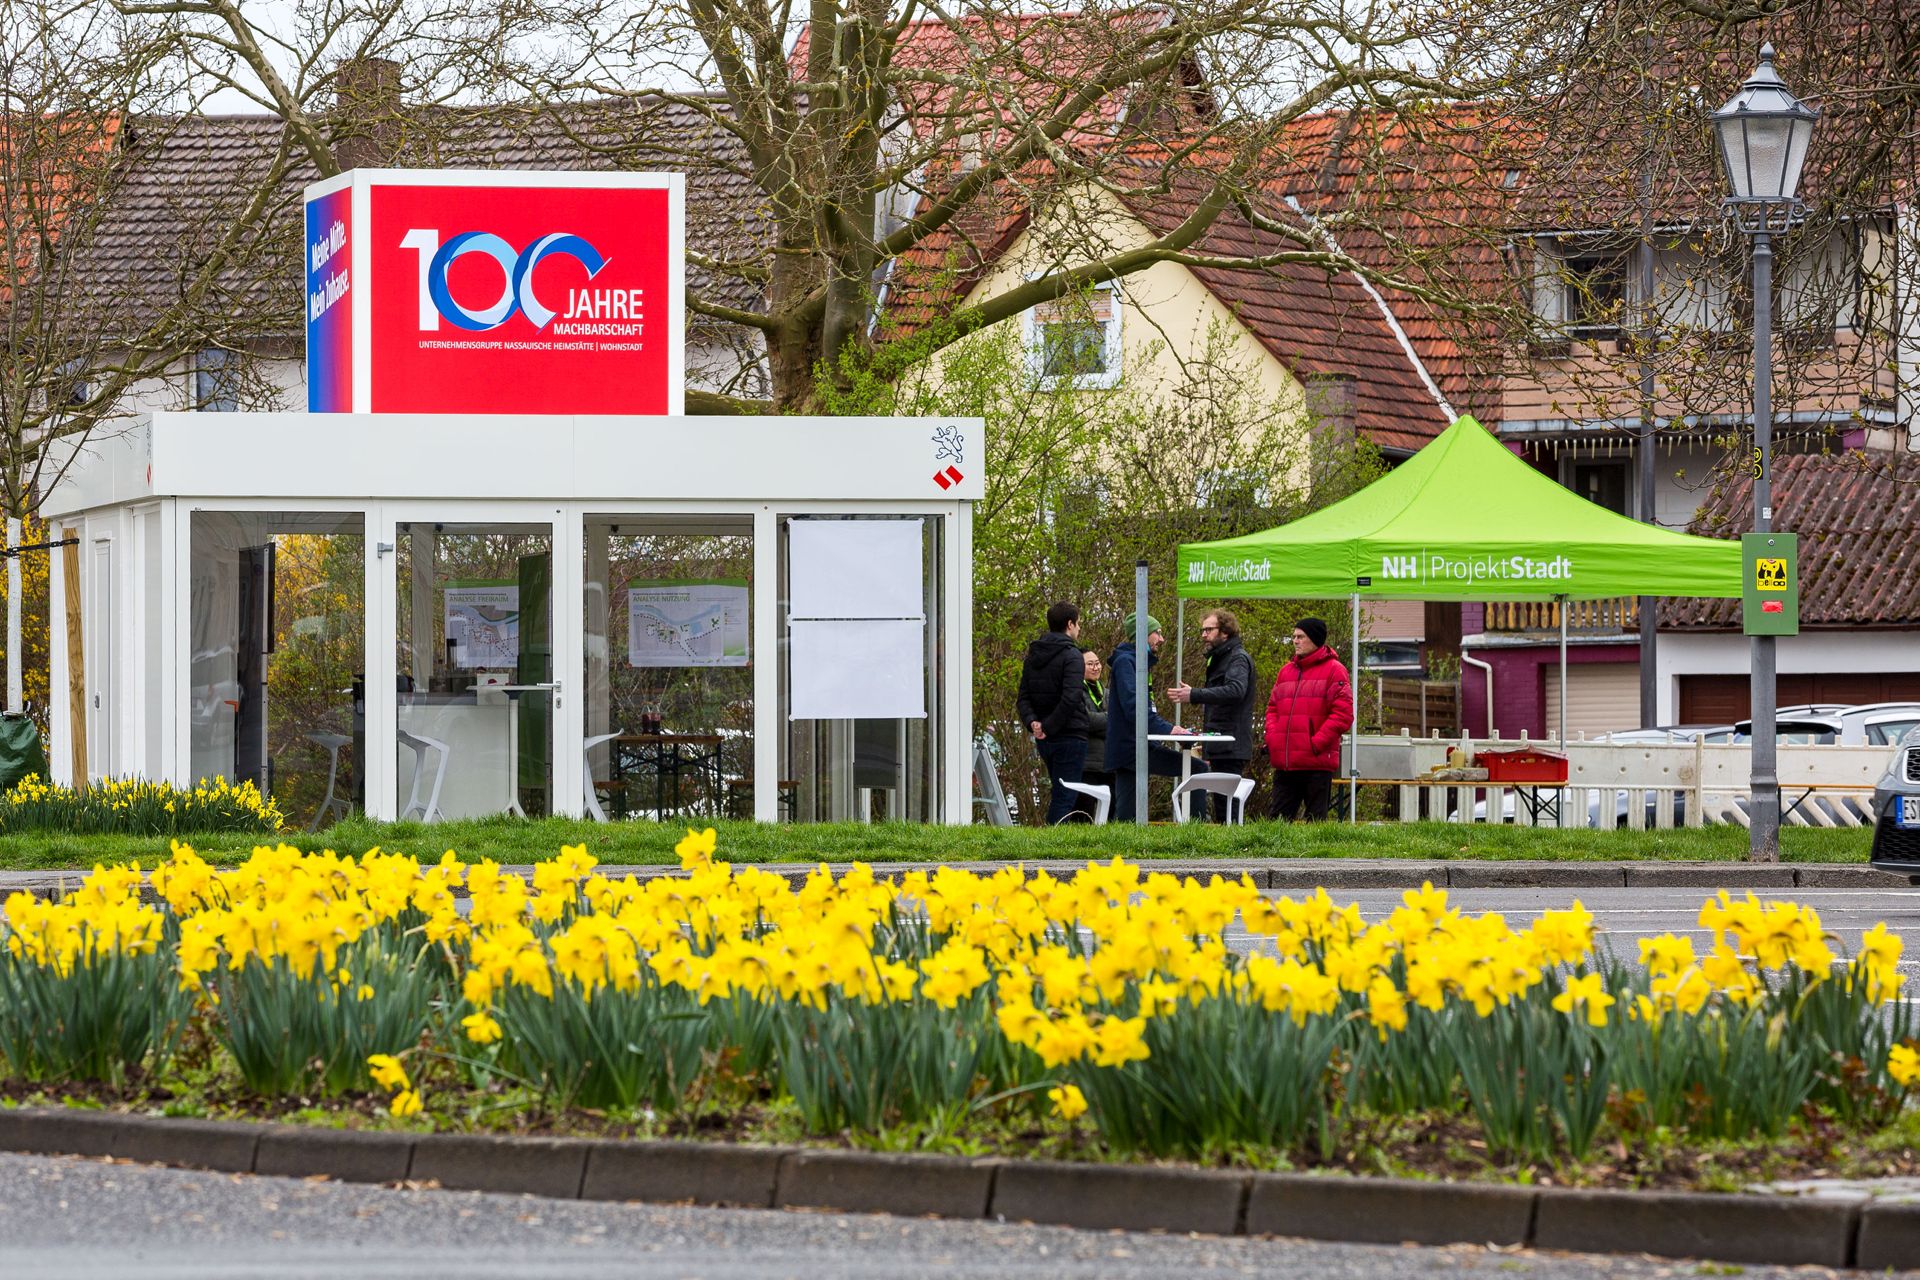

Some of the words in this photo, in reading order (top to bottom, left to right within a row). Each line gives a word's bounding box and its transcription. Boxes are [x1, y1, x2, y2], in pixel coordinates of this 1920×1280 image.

[311, 235, 330, 273] Meine
[330, 220, 347, 256] Mitte.
[310, 285, 326, 323] Mein
[325, 268, 350, 310] Zuhause.
[398, 228, 613, 334] 100
[563, 289, 644, 320] JAHRE
[553, 323, 644, 336] MACHBARSCHAFT
[418, 340, 503, 350] UNTERNEHMENSGRUPPE
[504, 341, 552, 351] NASSAUISCHE
[553, 341, 594, 351] HEIMSTÄTTE
[599, 342, 643, 351] WOHNSTADT
[1188, 561, 1205, 583] NH
[1208, 557, 1271, 588] ProjektStadt
[1382, 556, 1417, 579] NH
[1431, 555, 1572, 585] ProjektStadt
[449, 595, 476, 603] ANALYSE
[478, 595, 509, 603] FREIRAUM
[633, 595, 660, 603] ANALYSE
[662, 595, 690, 603] NUTZUNG
